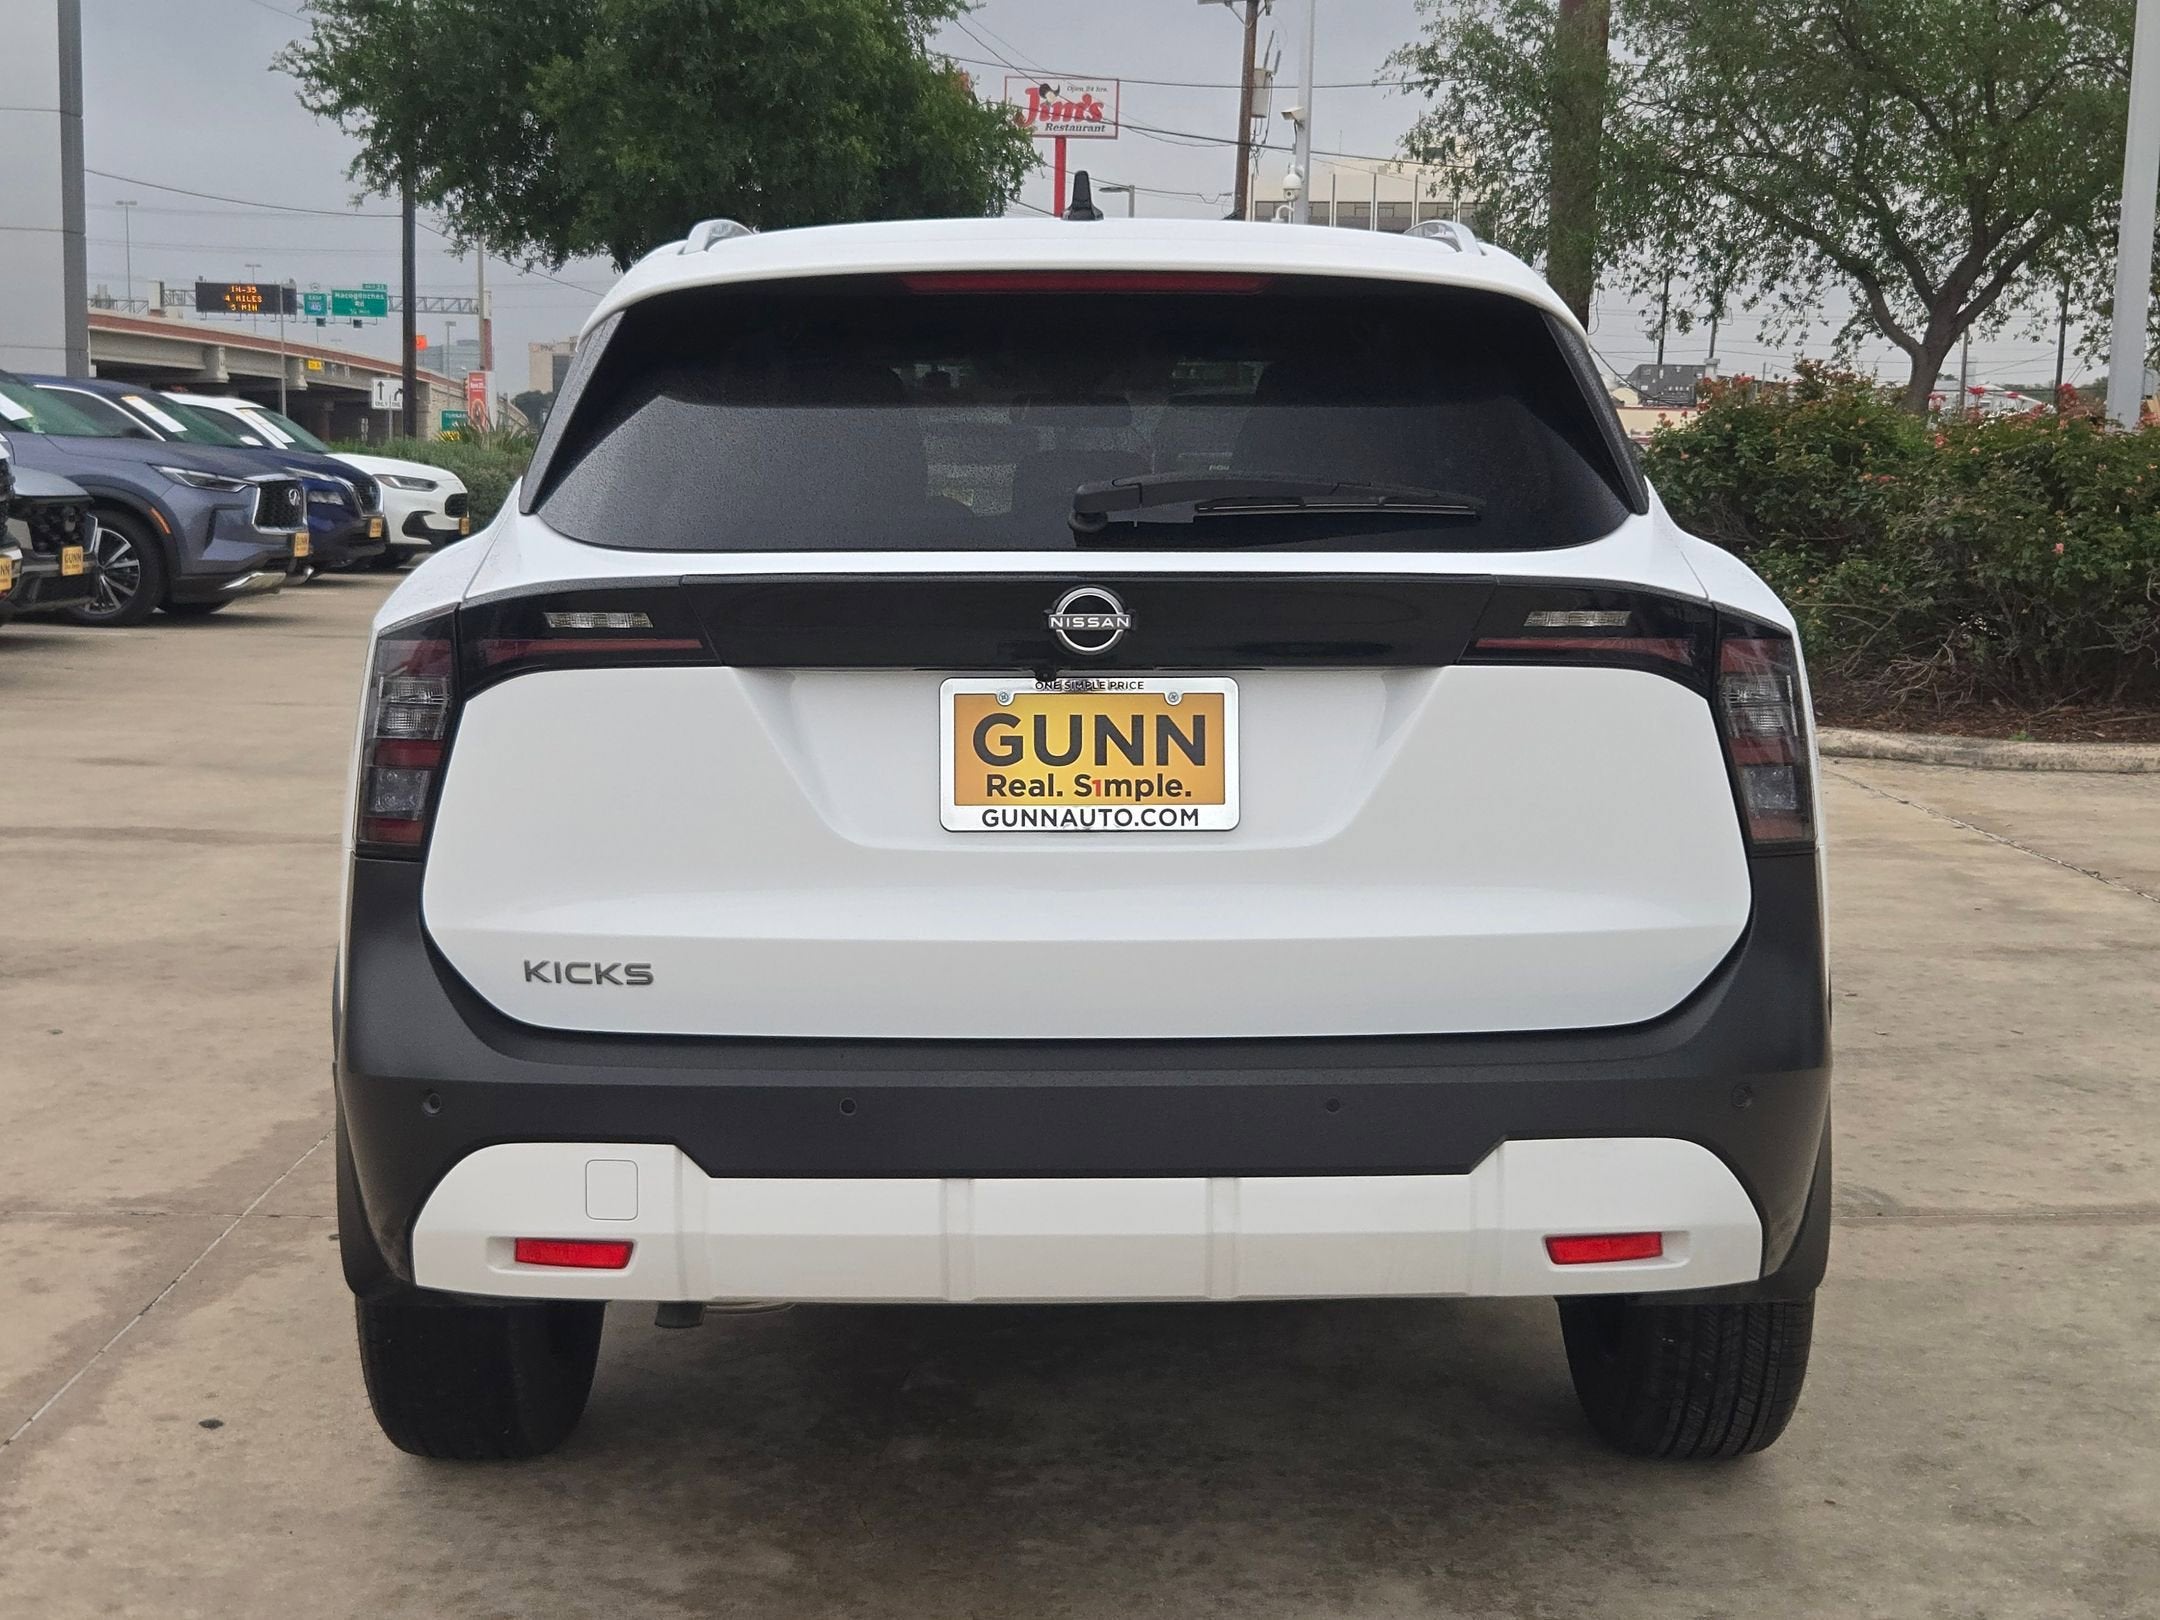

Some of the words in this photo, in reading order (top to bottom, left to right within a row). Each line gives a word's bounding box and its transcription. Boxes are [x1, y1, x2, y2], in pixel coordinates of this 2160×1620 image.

[1021, 86, 1105, 129] Jim's
[1045, 122, 1107, 133] Restaurant
[225, 293, 231, 302] 4
[235, 294, 263, 303] MILES
[241, 303, 258, 312] MIN
[1050, 616, 1130, 629] NISSAN
[1035, 680, 1062, 690] ONE
[1064, 681, 1107, 691] SIMPLE
[1109, 681, 1145, 690] PRICE
[972, 712, 1206, 767] GUNN
[986, 773, 1063, 798] Real.
[981, 808, 1199, 828] GUNNAUTO.COM
[523, 959, 654, 986] KICKS
